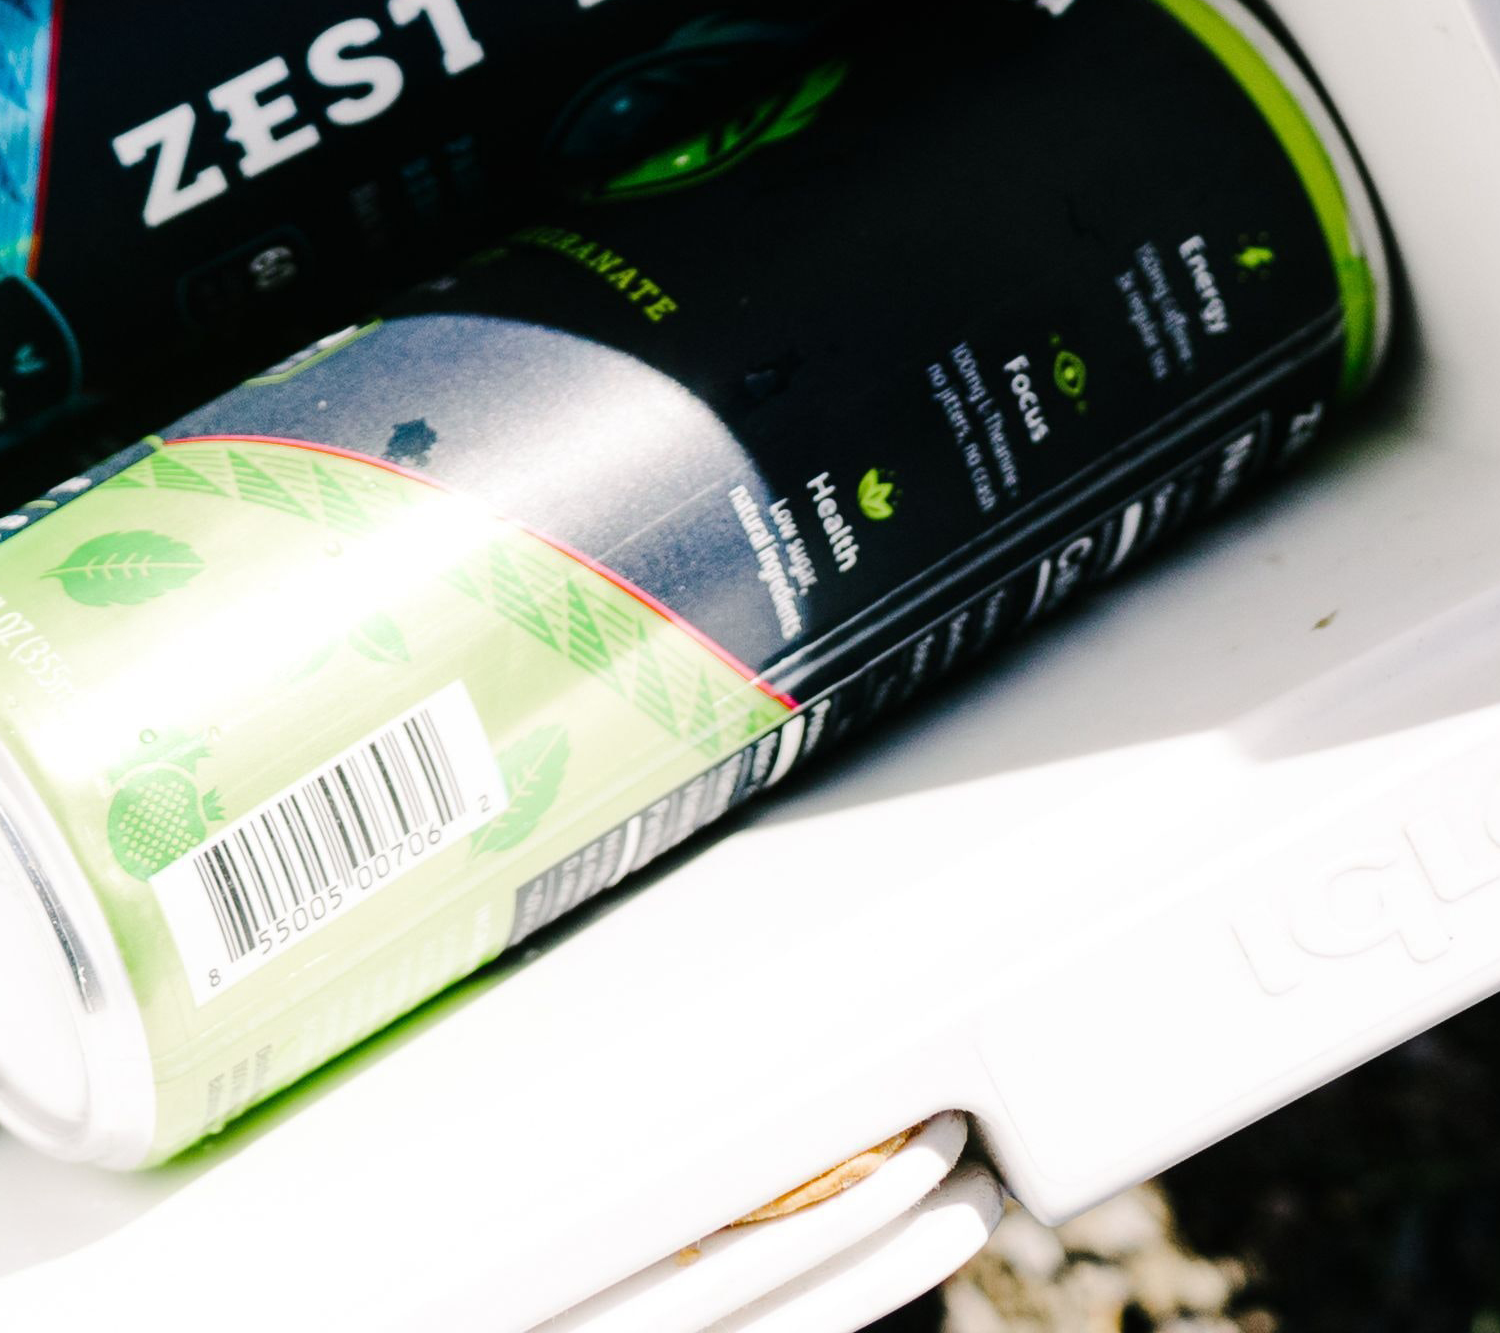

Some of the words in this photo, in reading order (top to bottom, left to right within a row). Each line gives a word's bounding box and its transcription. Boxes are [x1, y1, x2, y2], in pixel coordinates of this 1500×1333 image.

[1178, 235, 1229, 333] Energy
[927, 363, 947, 388] no
[951, 341, 986, 403] 100mg
[1003, 354, 1050, 443] Focus
[964, 442, 983, 467] no
[972, 467, 997, 512] crash
[728, 485, 776, 552] natural
[757, 542, 802, 641] ingredients
[769, 498, 799, 540] Low
[785, 538, 818, 596] sugar,
[806, 471, 860, 573] Health
[208, 968, 222, 987] 8
[258, 885, 343, 954] 55005
[357, 823, 442, 890] 00706
[478, 794, 491, 813] 2
